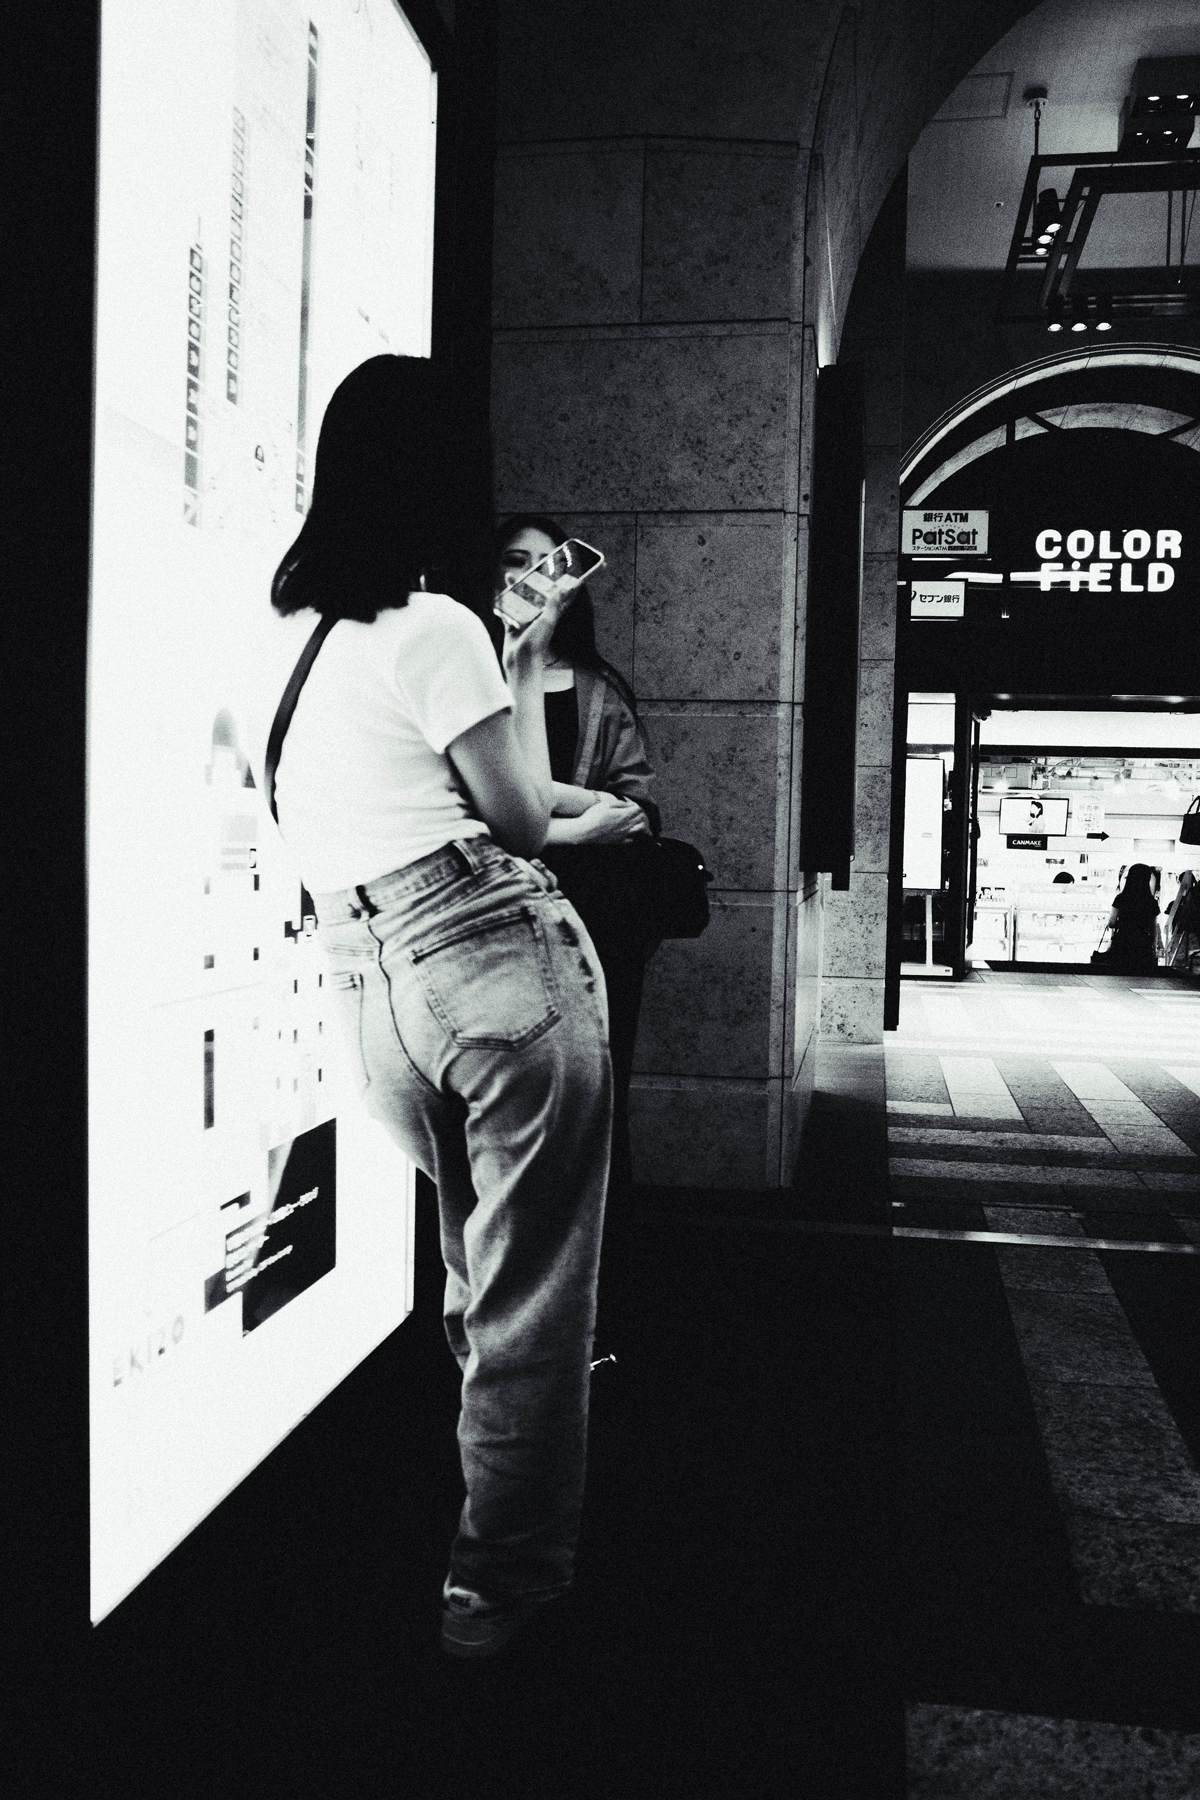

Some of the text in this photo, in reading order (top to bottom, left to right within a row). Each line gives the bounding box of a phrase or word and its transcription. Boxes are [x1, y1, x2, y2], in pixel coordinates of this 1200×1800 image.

[923, 512, 969, 523] 銀行ATM
[912, 528, 978, 545] PatSat
[1035, 529, 1182, 559] COLOR
